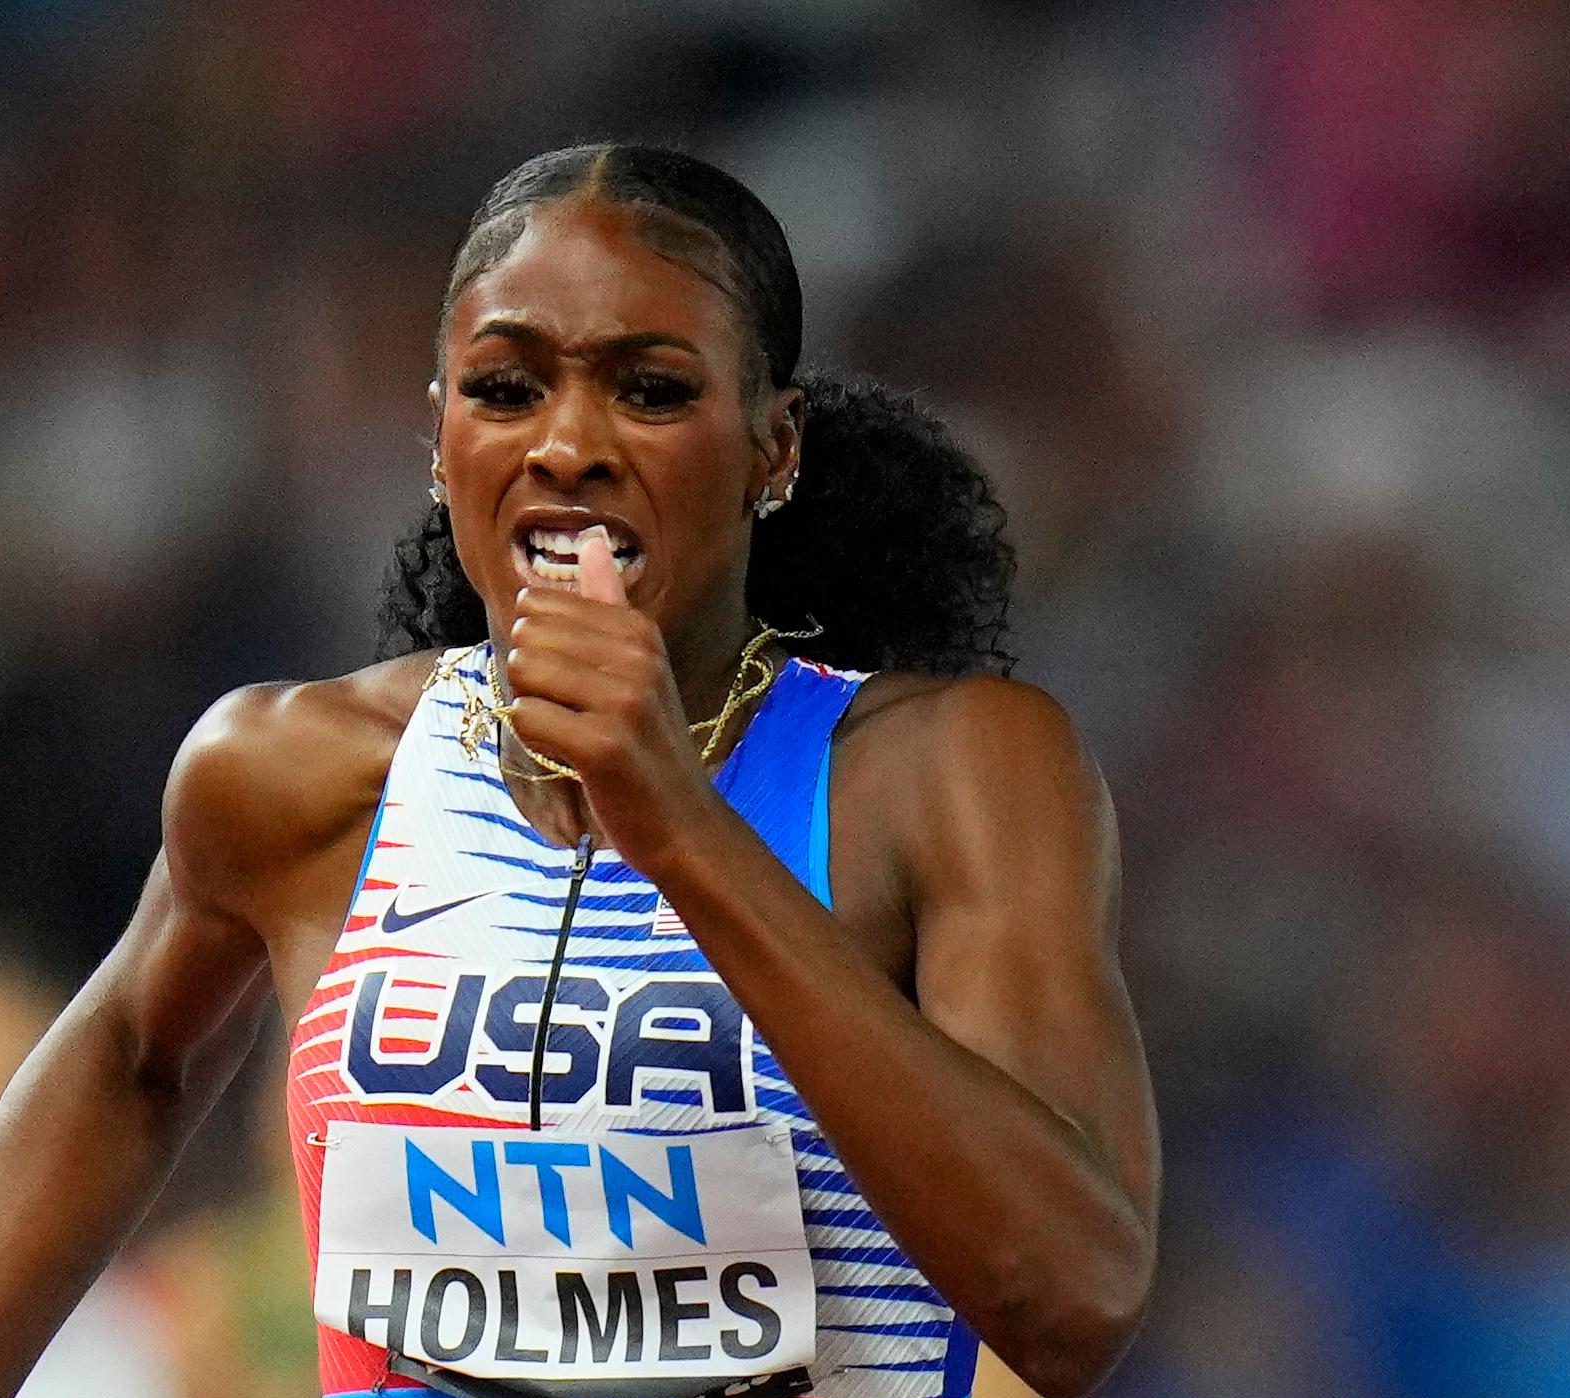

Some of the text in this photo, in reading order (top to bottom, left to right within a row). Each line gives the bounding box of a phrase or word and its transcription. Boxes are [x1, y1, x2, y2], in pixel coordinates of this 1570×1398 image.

[344, 968, 751, 1116] USA
[404, 1136, 707, 1250] NTN
[347, 1261, 783, 1363] HOLMES
